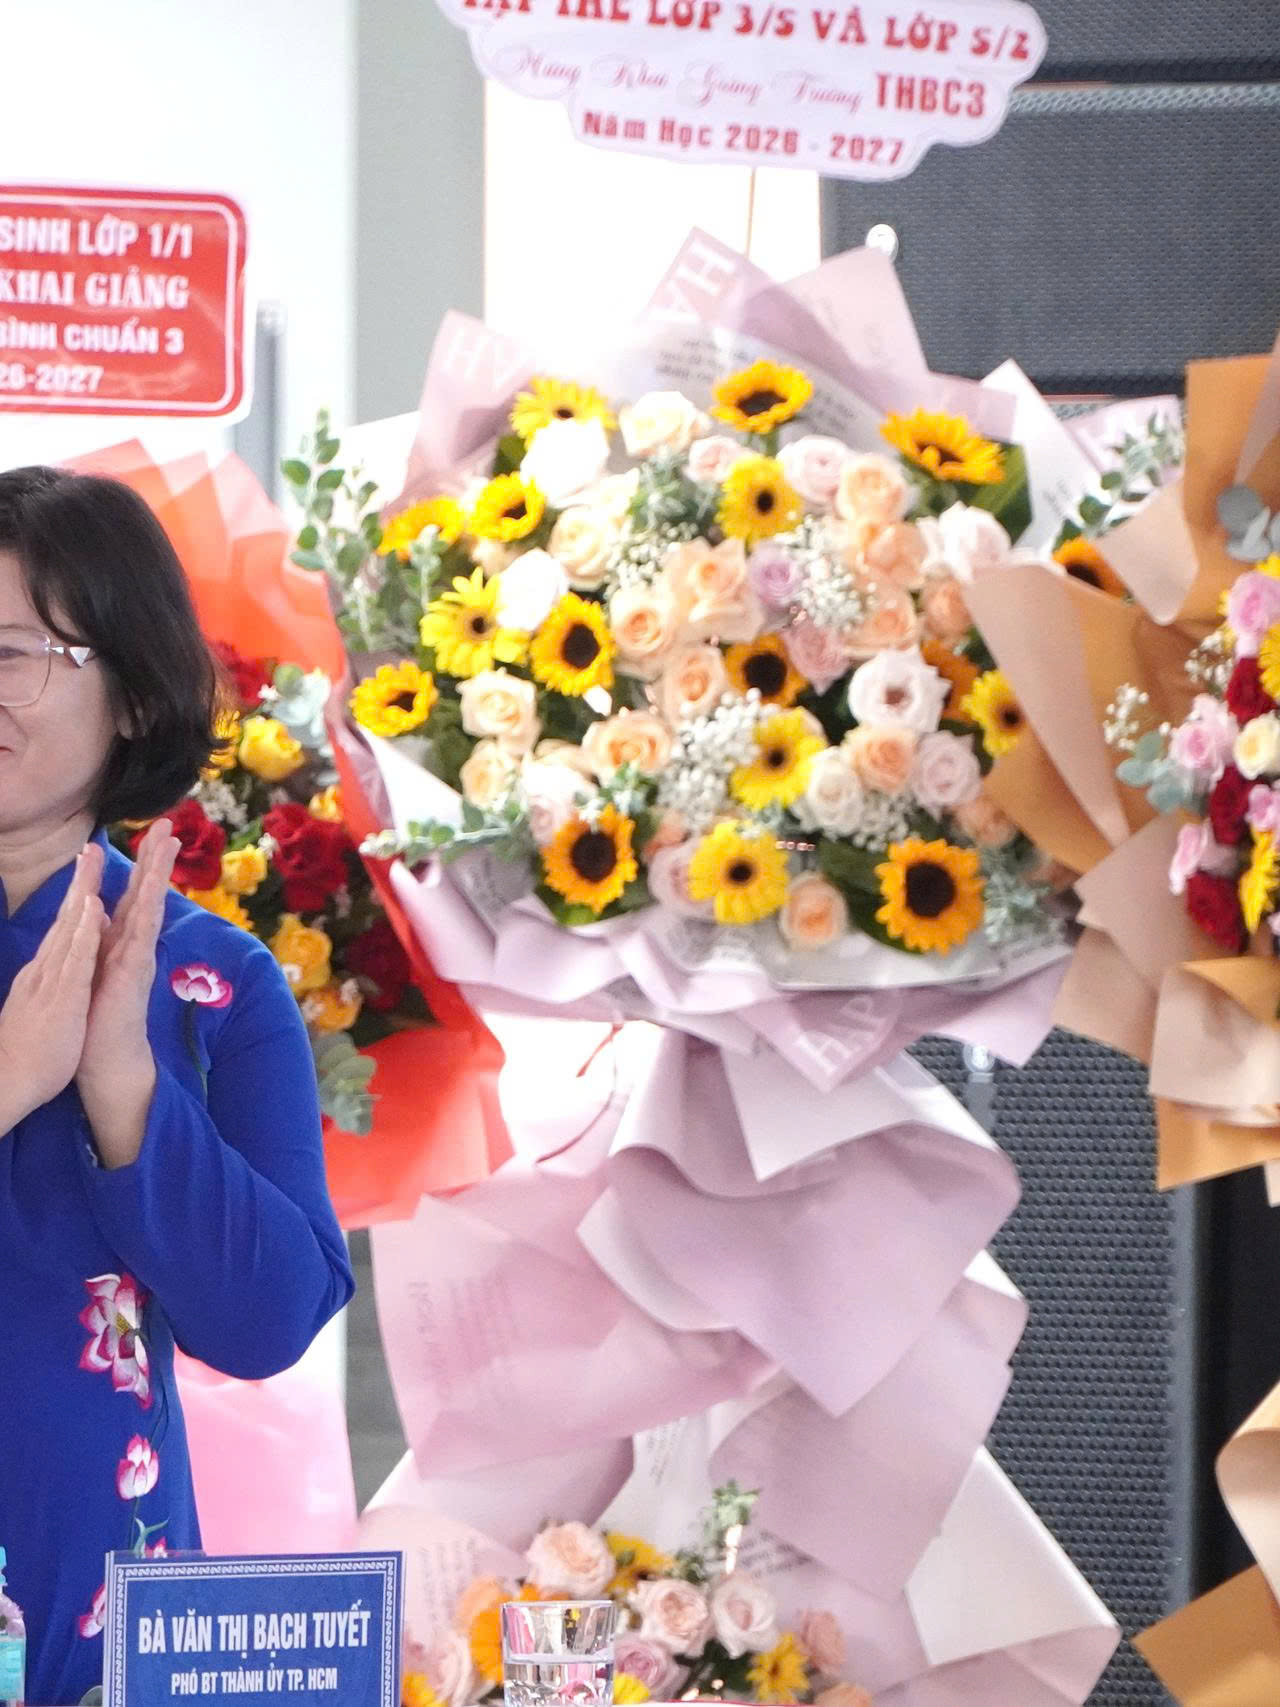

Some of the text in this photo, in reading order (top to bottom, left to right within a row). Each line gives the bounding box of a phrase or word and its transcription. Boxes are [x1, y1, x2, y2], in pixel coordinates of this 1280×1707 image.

[884, 12, 957, 52] LỚP
[970, 25, 1031, 60] 5/2
[875, 72, 986, 118] THBC3
[659, 116, 713, 148] Học
[724, 124, 800, 156] 2026
[830, 133, 904, 166] 2027
[78, 213, 139, 257] LỚP
[147, 222, 193, 259] 1/1
[84, 264, 190, 310] GIẢNG
[163, 327, 185, 356] 3
[138, 1599, 371, 1660] BÀ VĂN THỊ BẠCH TUYẾT
[171, 1667, 198, 1695] PHÓ
[201, 1672, 218, 1695] BT
[221, 1666, 264, 1694] THÀNH
[287, 1668, 305, 1691] TP.
[308, 1667, 337, 1691] HCM
